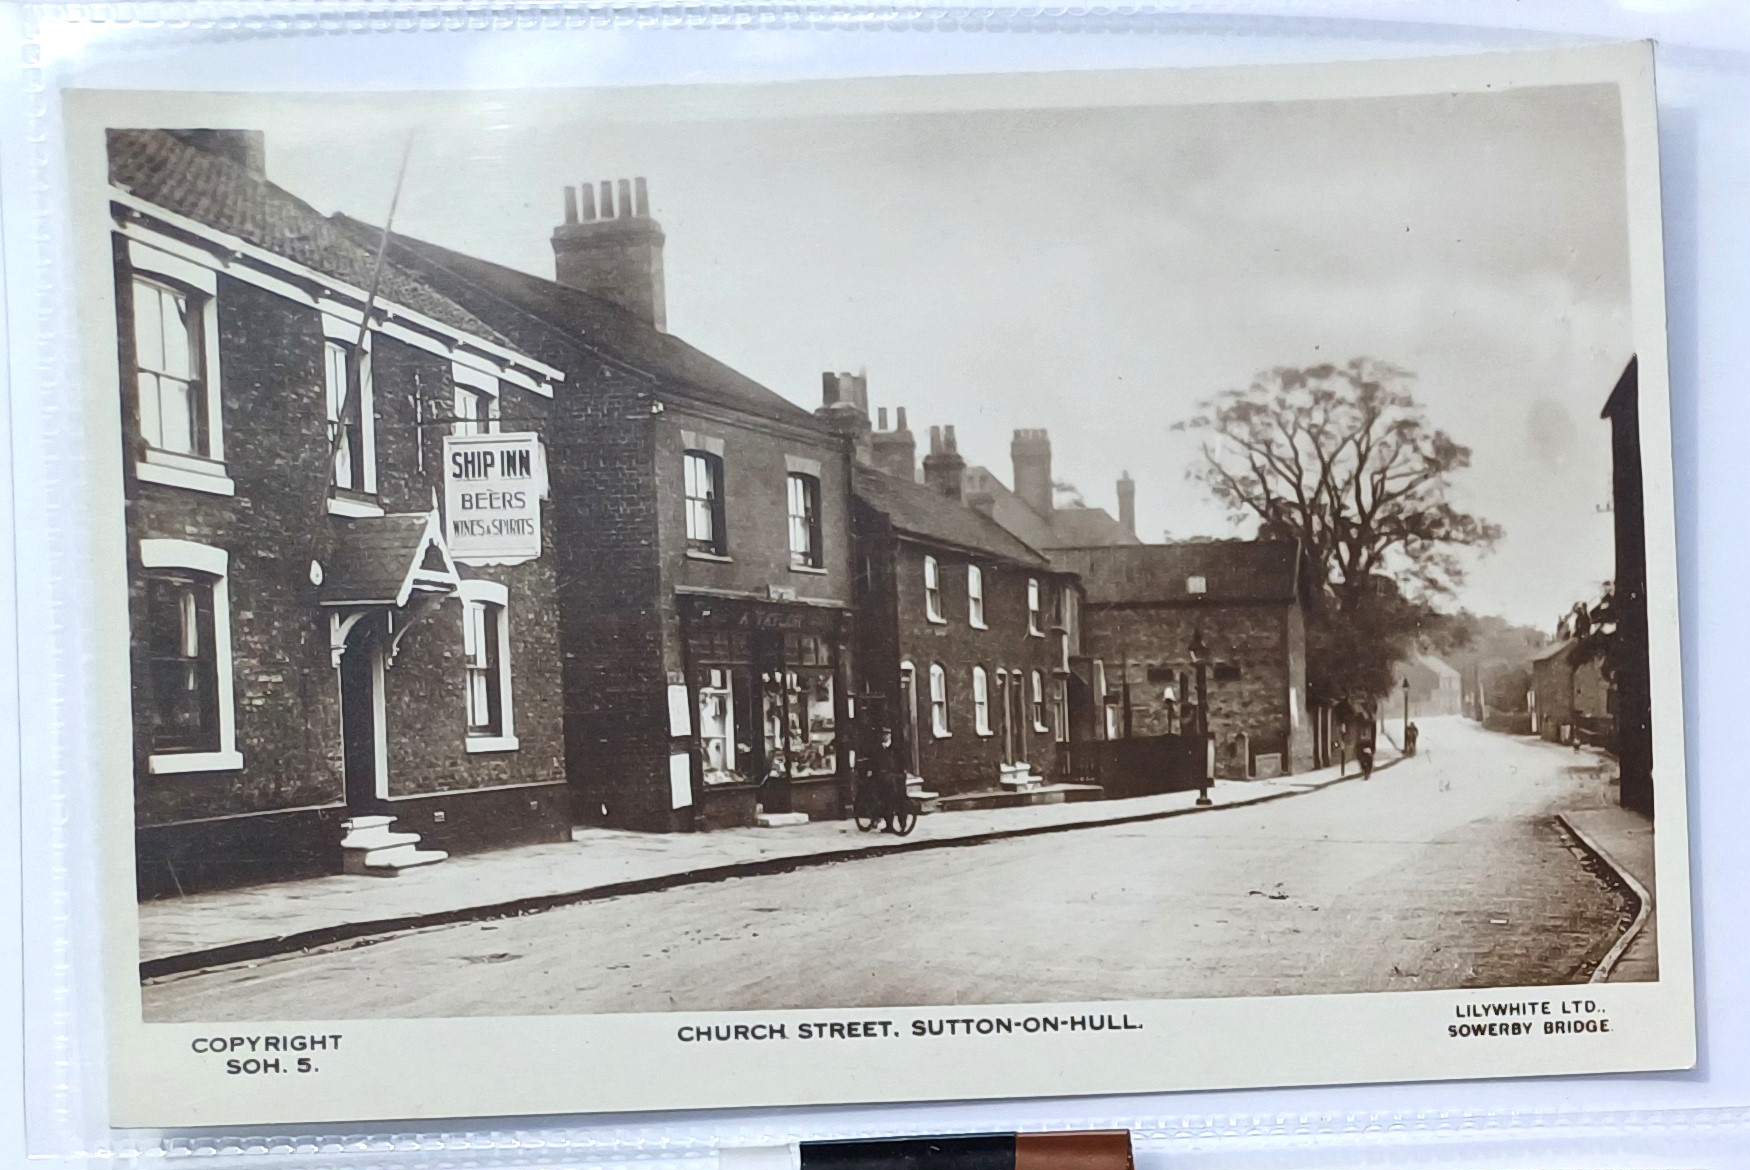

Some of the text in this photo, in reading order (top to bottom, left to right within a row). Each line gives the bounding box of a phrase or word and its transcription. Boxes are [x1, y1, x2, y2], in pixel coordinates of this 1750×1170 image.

[451, 449, 531, 479] SHIP INN
[461, 490, 526, 511] BEERS
[453, 519, 485, 536] WINES
[491, 518, 535, 536] SPIRITS
[1455, 1001, 1552, 1018] LILYWHITE
[677, 1023, 788, 1042] CHURCH
[911, 1014, 1143, 1036] SUTTON-ON-HULL.
[1448, 1022, 1533, 1038] SOWERBY
[191, 1034, 343, 1054] COPYRIGHT
[226, 1057, 320, 1075] SOH. 5.
